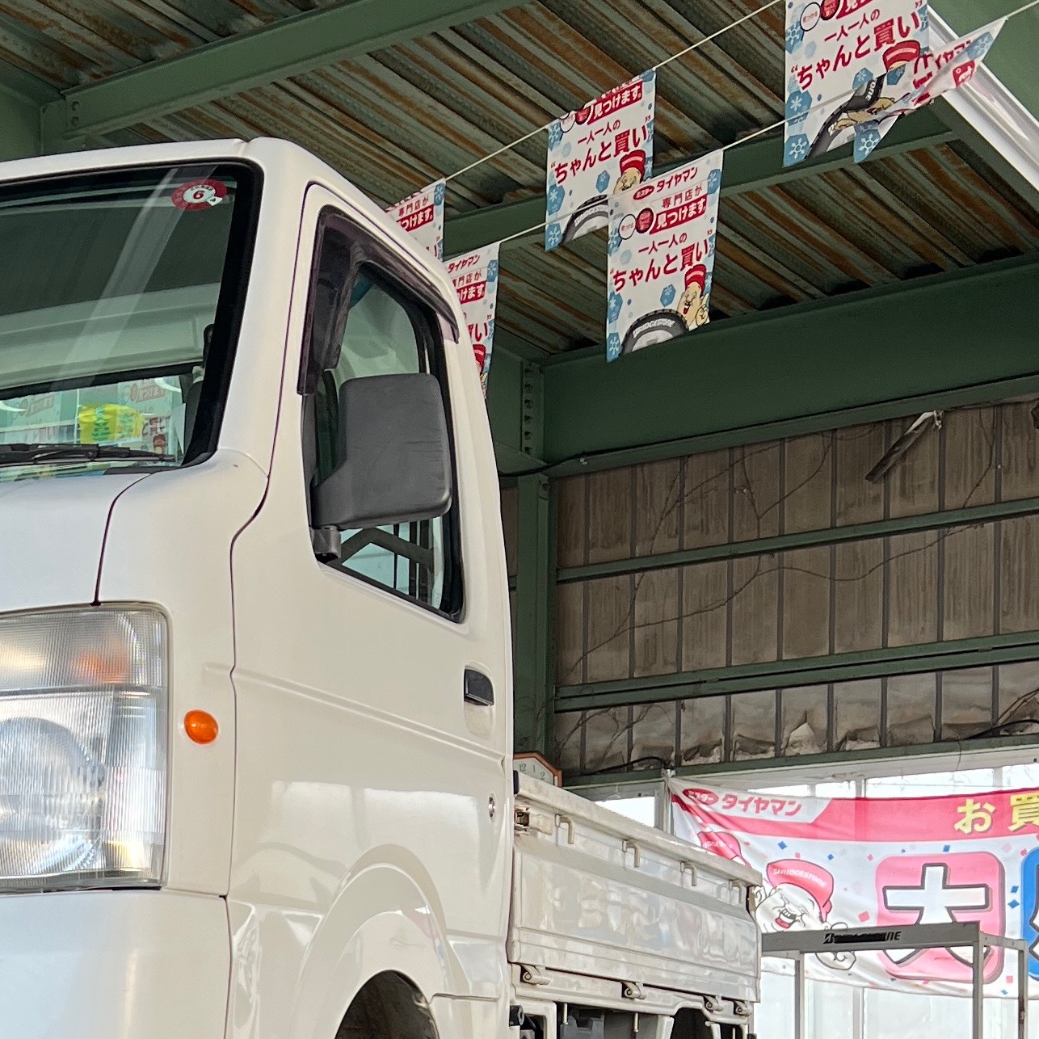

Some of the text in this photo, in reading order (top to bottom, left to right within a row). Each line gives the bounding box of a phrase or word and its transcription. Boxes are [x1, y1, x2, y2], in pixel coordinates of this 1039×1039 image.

[824, 9, 880, 41] 一人一人の
[577, 119, 621, 145] 一人一人の
[657, 167, 698, 193] タイヤマン
[662, 185, 703, 208] 専門店が
[400, 208, 433, 232] つけます。
[638, 232, 688, 255] 一人一人の
[448, 254, 480, 274] タイヤマン
[722, 793, 802, 816] タイヤマン
